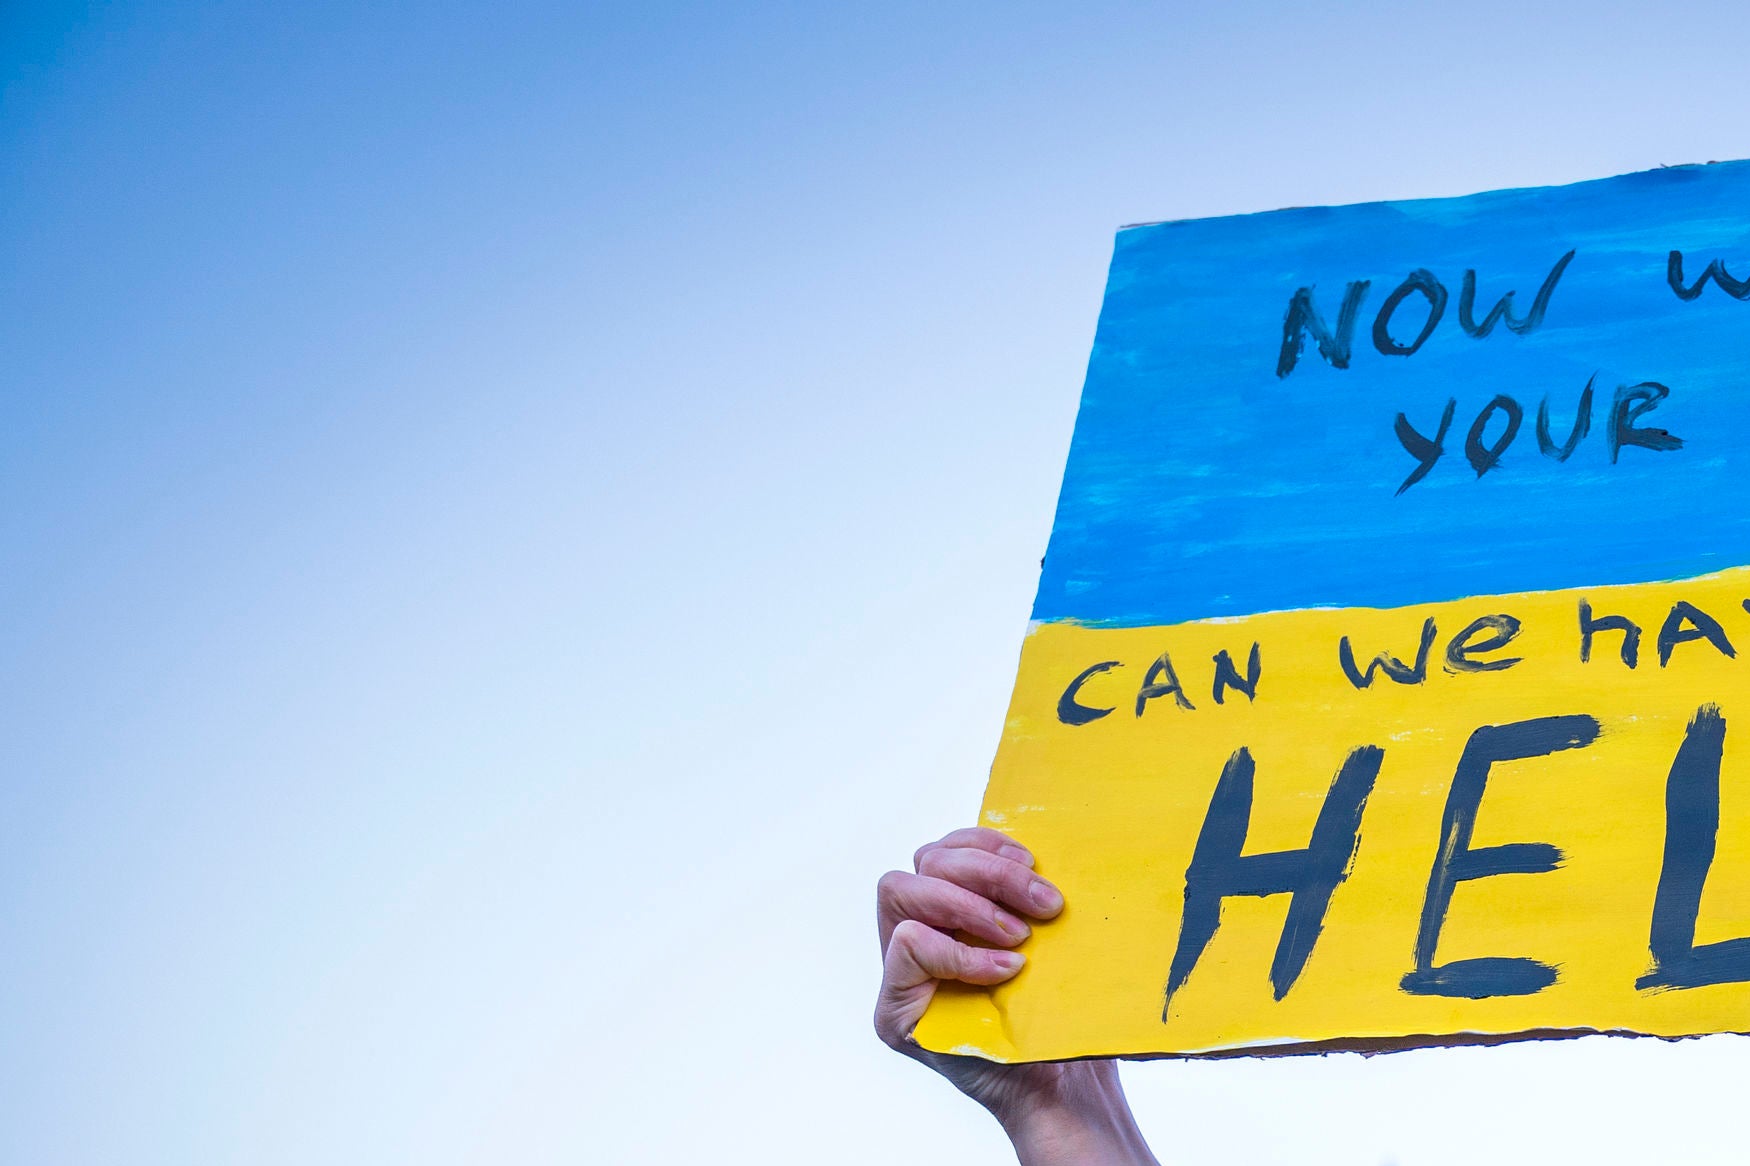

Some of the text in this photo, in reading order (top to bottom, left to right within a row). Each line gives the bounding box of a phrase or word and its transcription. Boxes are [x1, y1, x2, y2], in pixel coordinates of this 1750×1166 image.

[1276, 250, 1575, 379] NOW
[1394, 374, 1683, 492] YOUR
[1056, 641, 1262, 727] CAN
